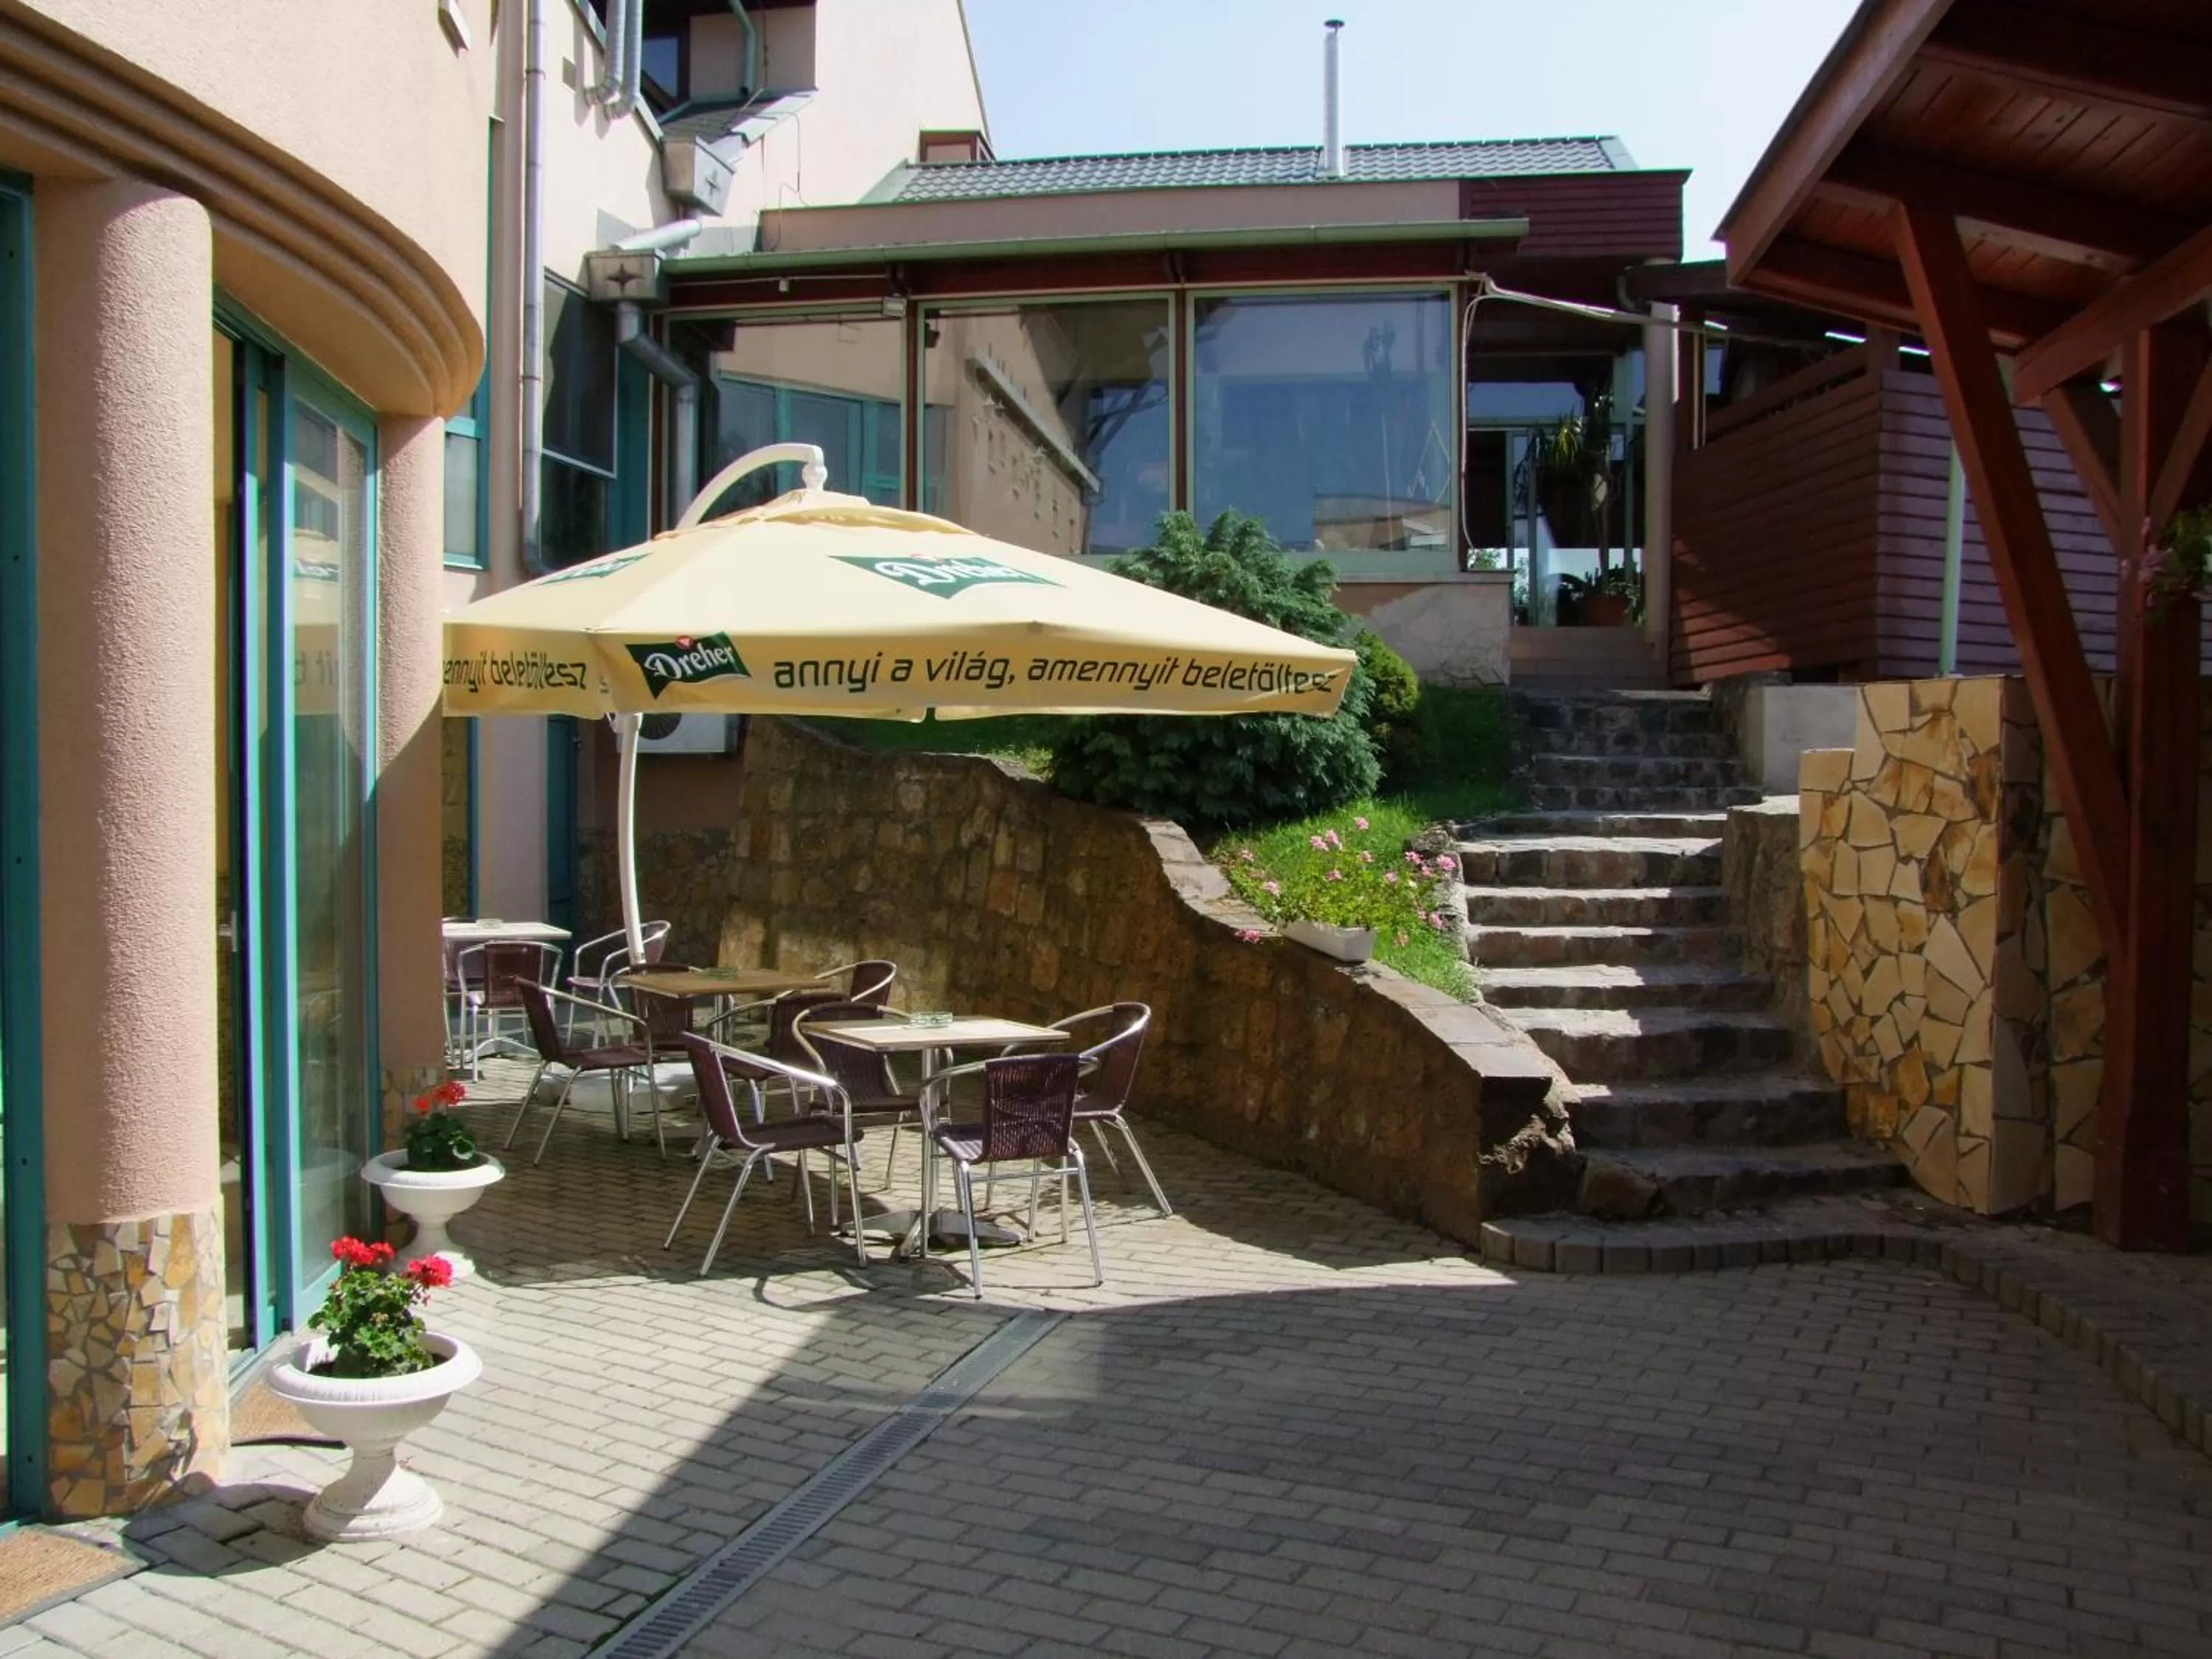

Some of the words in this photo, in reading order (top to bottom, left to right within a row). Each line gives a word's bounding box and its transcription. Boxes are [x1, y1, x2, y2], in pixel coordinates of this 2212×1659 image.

[644, 640, 736, 680] Dreher
[774, 652, 883, 693] annyi
[891, 658, 914, 682] a
[927, 650, 1015, 689] világ,
[1028, 657, 1180, 691] amennyit
